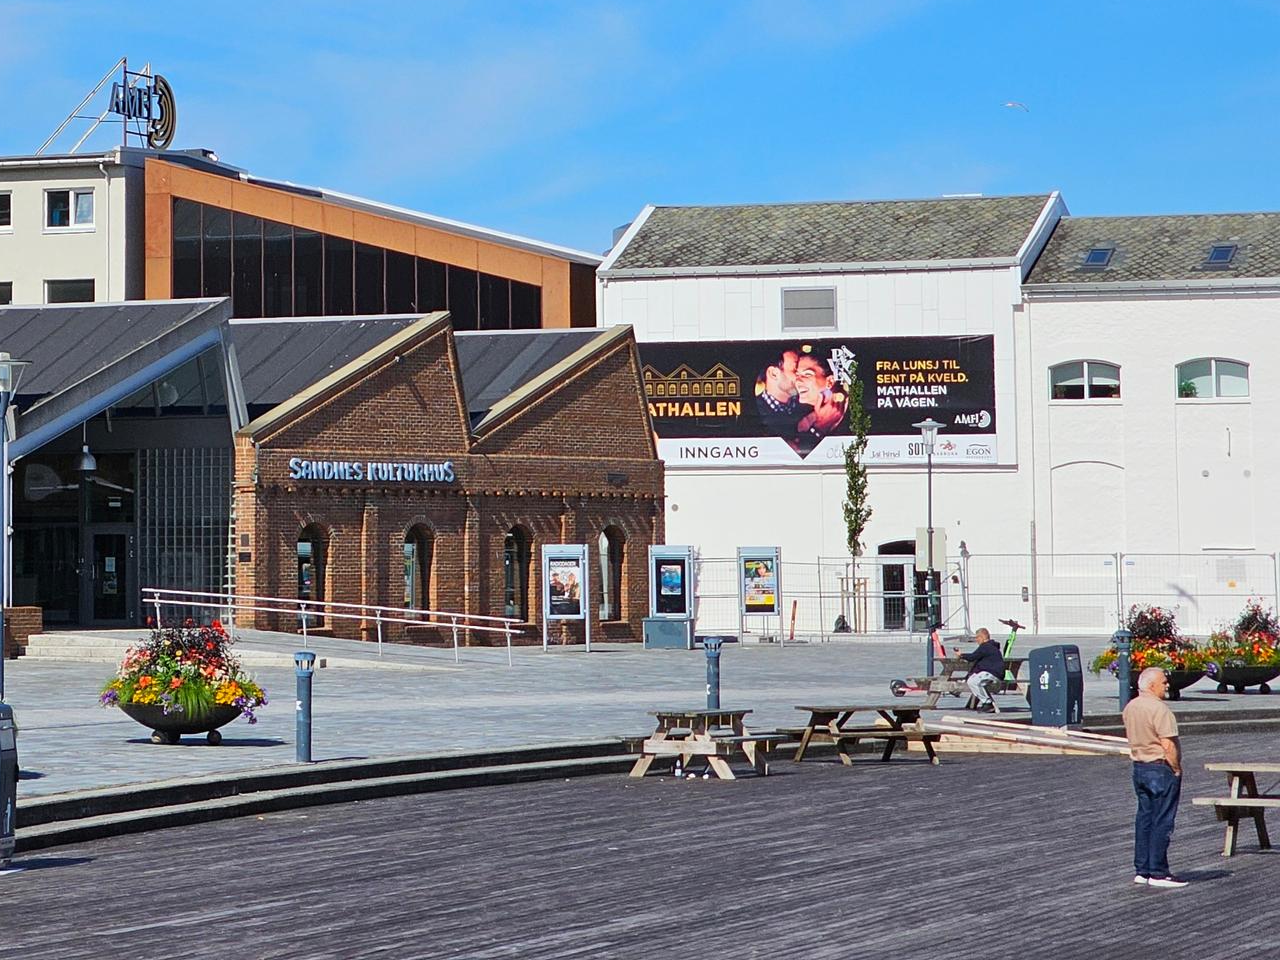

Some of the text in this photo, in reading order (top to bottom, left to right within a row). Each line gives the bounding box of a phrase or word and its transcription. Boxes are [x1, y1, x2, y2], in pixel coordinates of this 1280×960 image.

[876, 359, 960, 371] FRA LUNSJ TIL
[876, 371, 969, 384] SENT PÅ KVELD.
[877, 385, 947, 396] MATHALLEN
[877, 395, 939, 409] PÅ VÅGEN.
[648, 402, 741, 417] ATHALLEN
[954, 413, 979, 425] AMFI
[680, 445, 759, 459] INNGANG
[966, 447, 991, 456] EGON
[289, 457, 455, 482] SANDNES KULTURHUS
